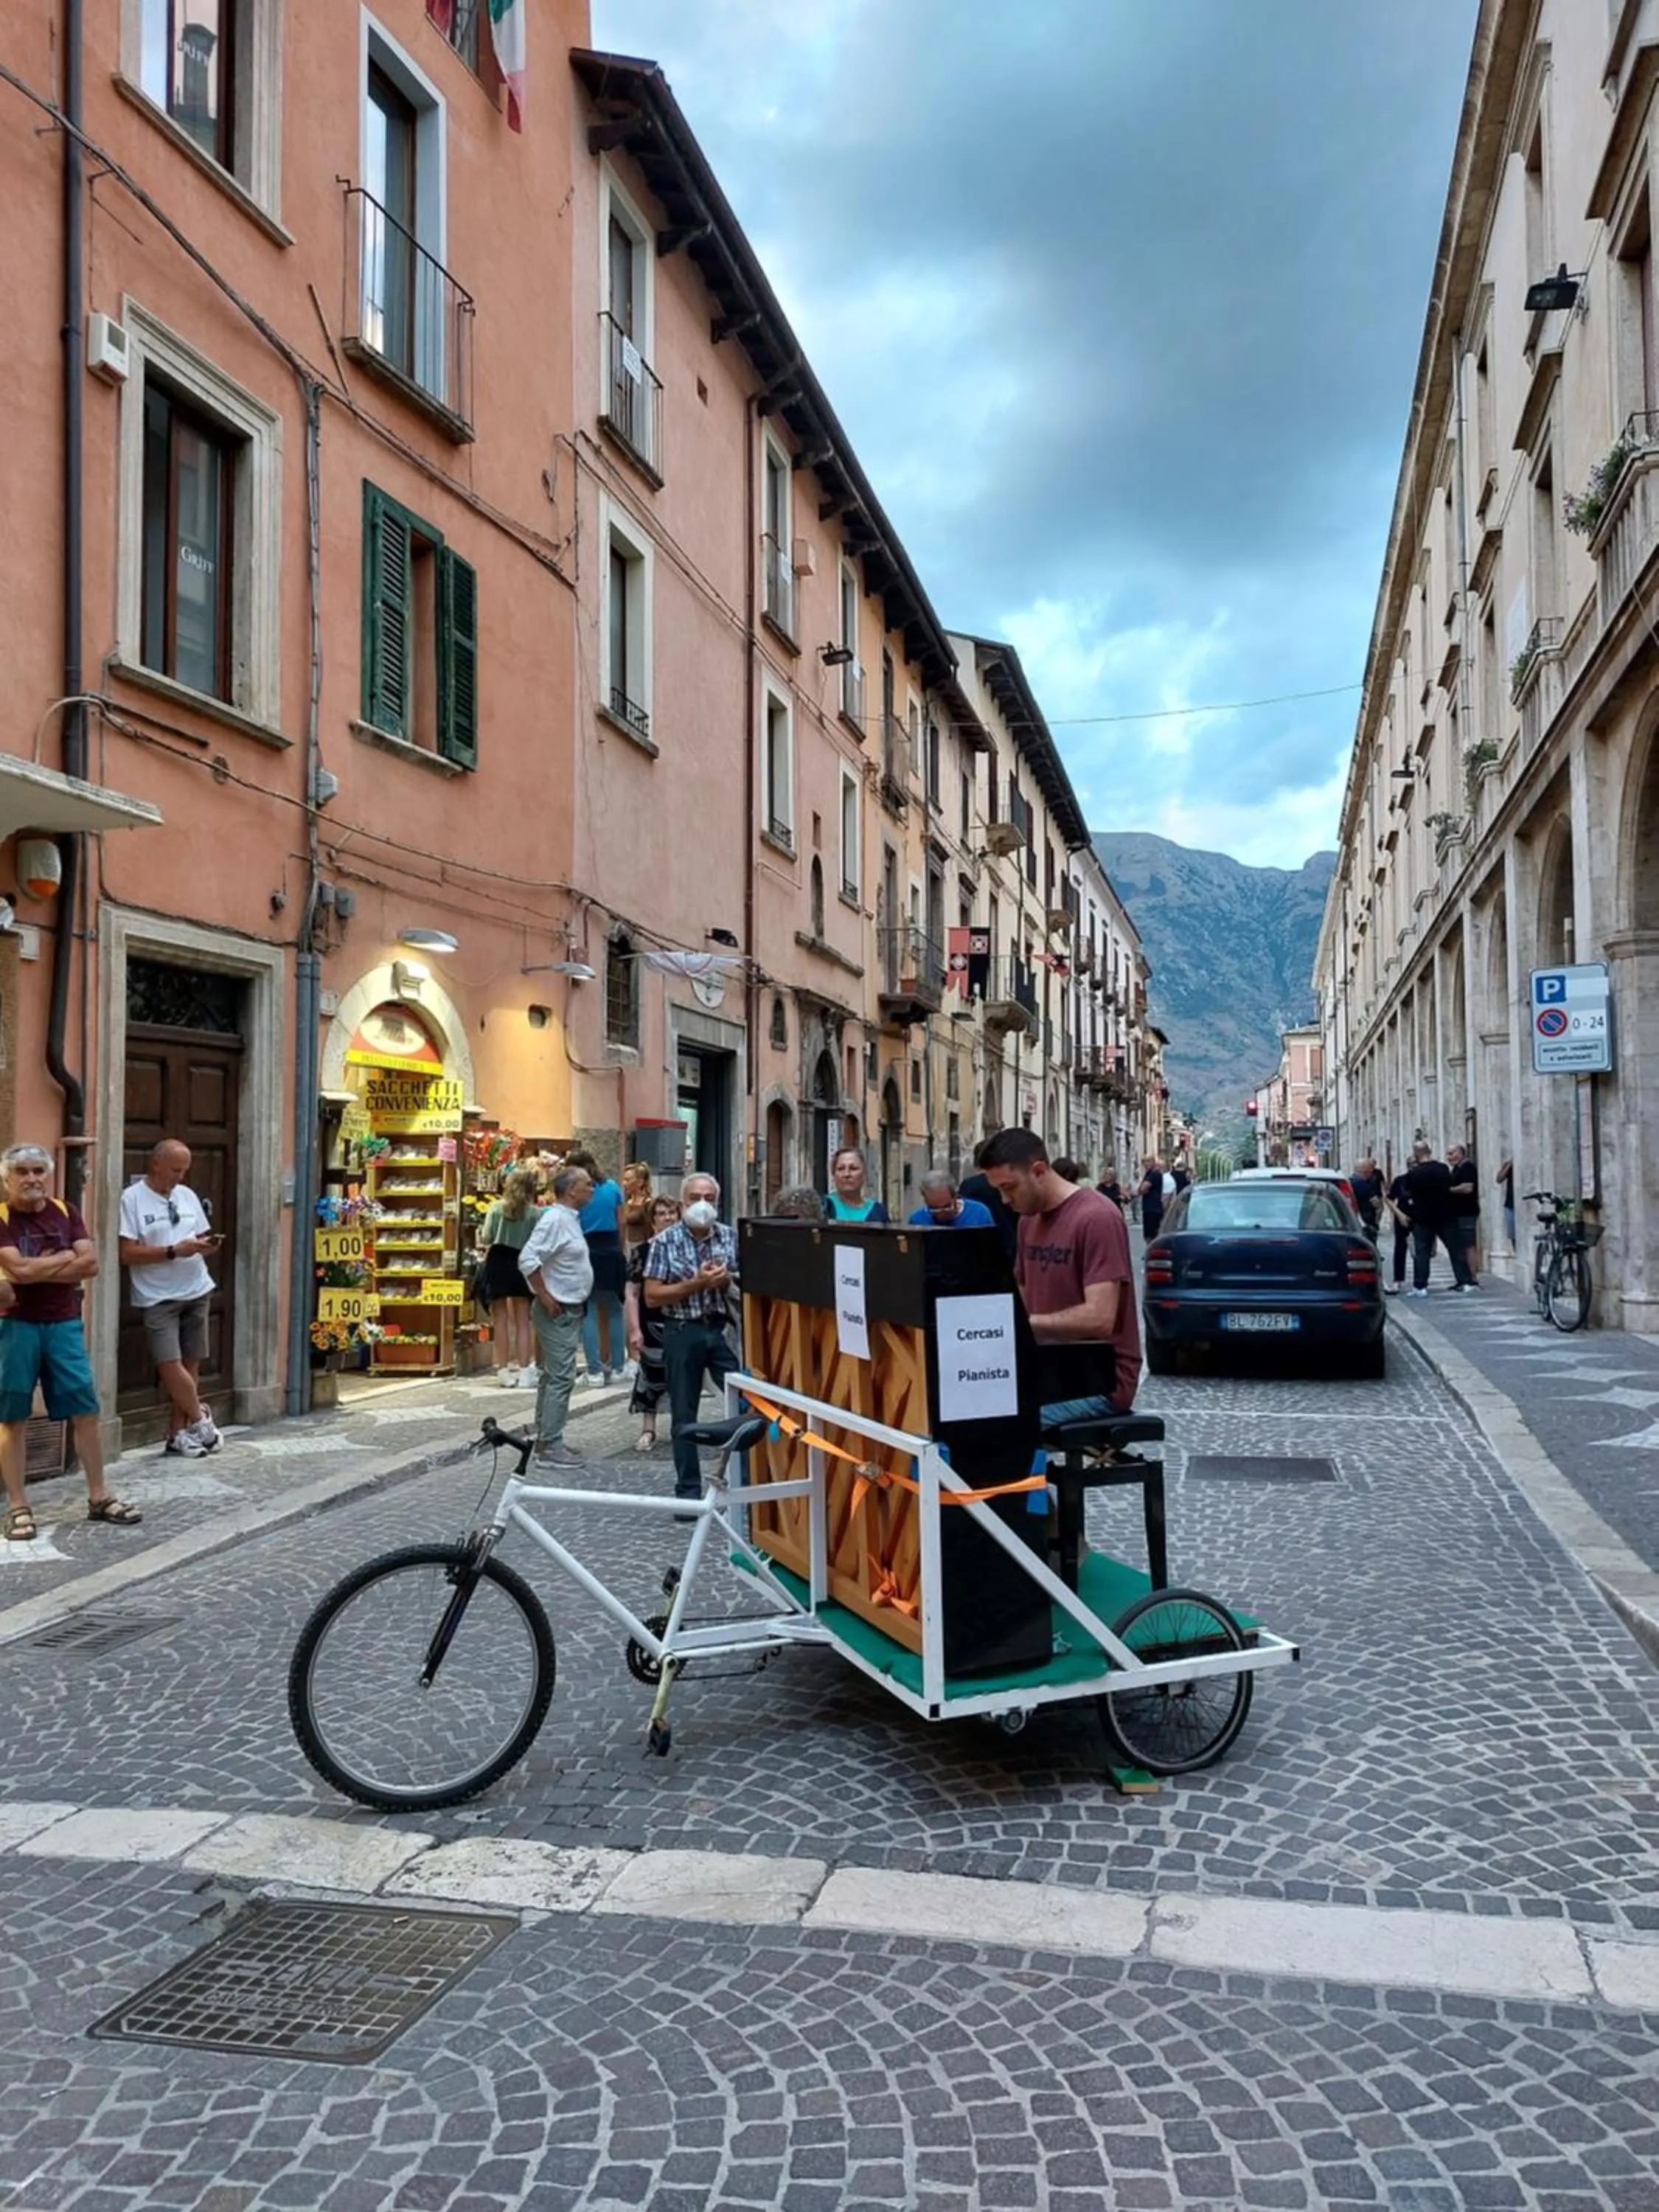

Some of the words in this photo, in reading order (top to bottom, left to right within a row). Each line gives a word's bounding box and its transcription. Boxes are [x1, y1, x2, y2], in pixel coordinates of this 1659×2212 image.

[1543, 978, 1562, 1001] P
[1573, 1018, 1580, 1029] 0
[1590, 1016, 1604, 1029] 24
[366, 1079, 458, 1095] SACCHETTI
[365, 1096, 461, 1110] CONVENIENZA
[322, 1237, 361, 1259] 1,00
[325, 1298, 361, 1318] 1,90
[957, 1325, 1004, 1340] Cercasi
[958, 1368, 1010, 1381] Pianista
